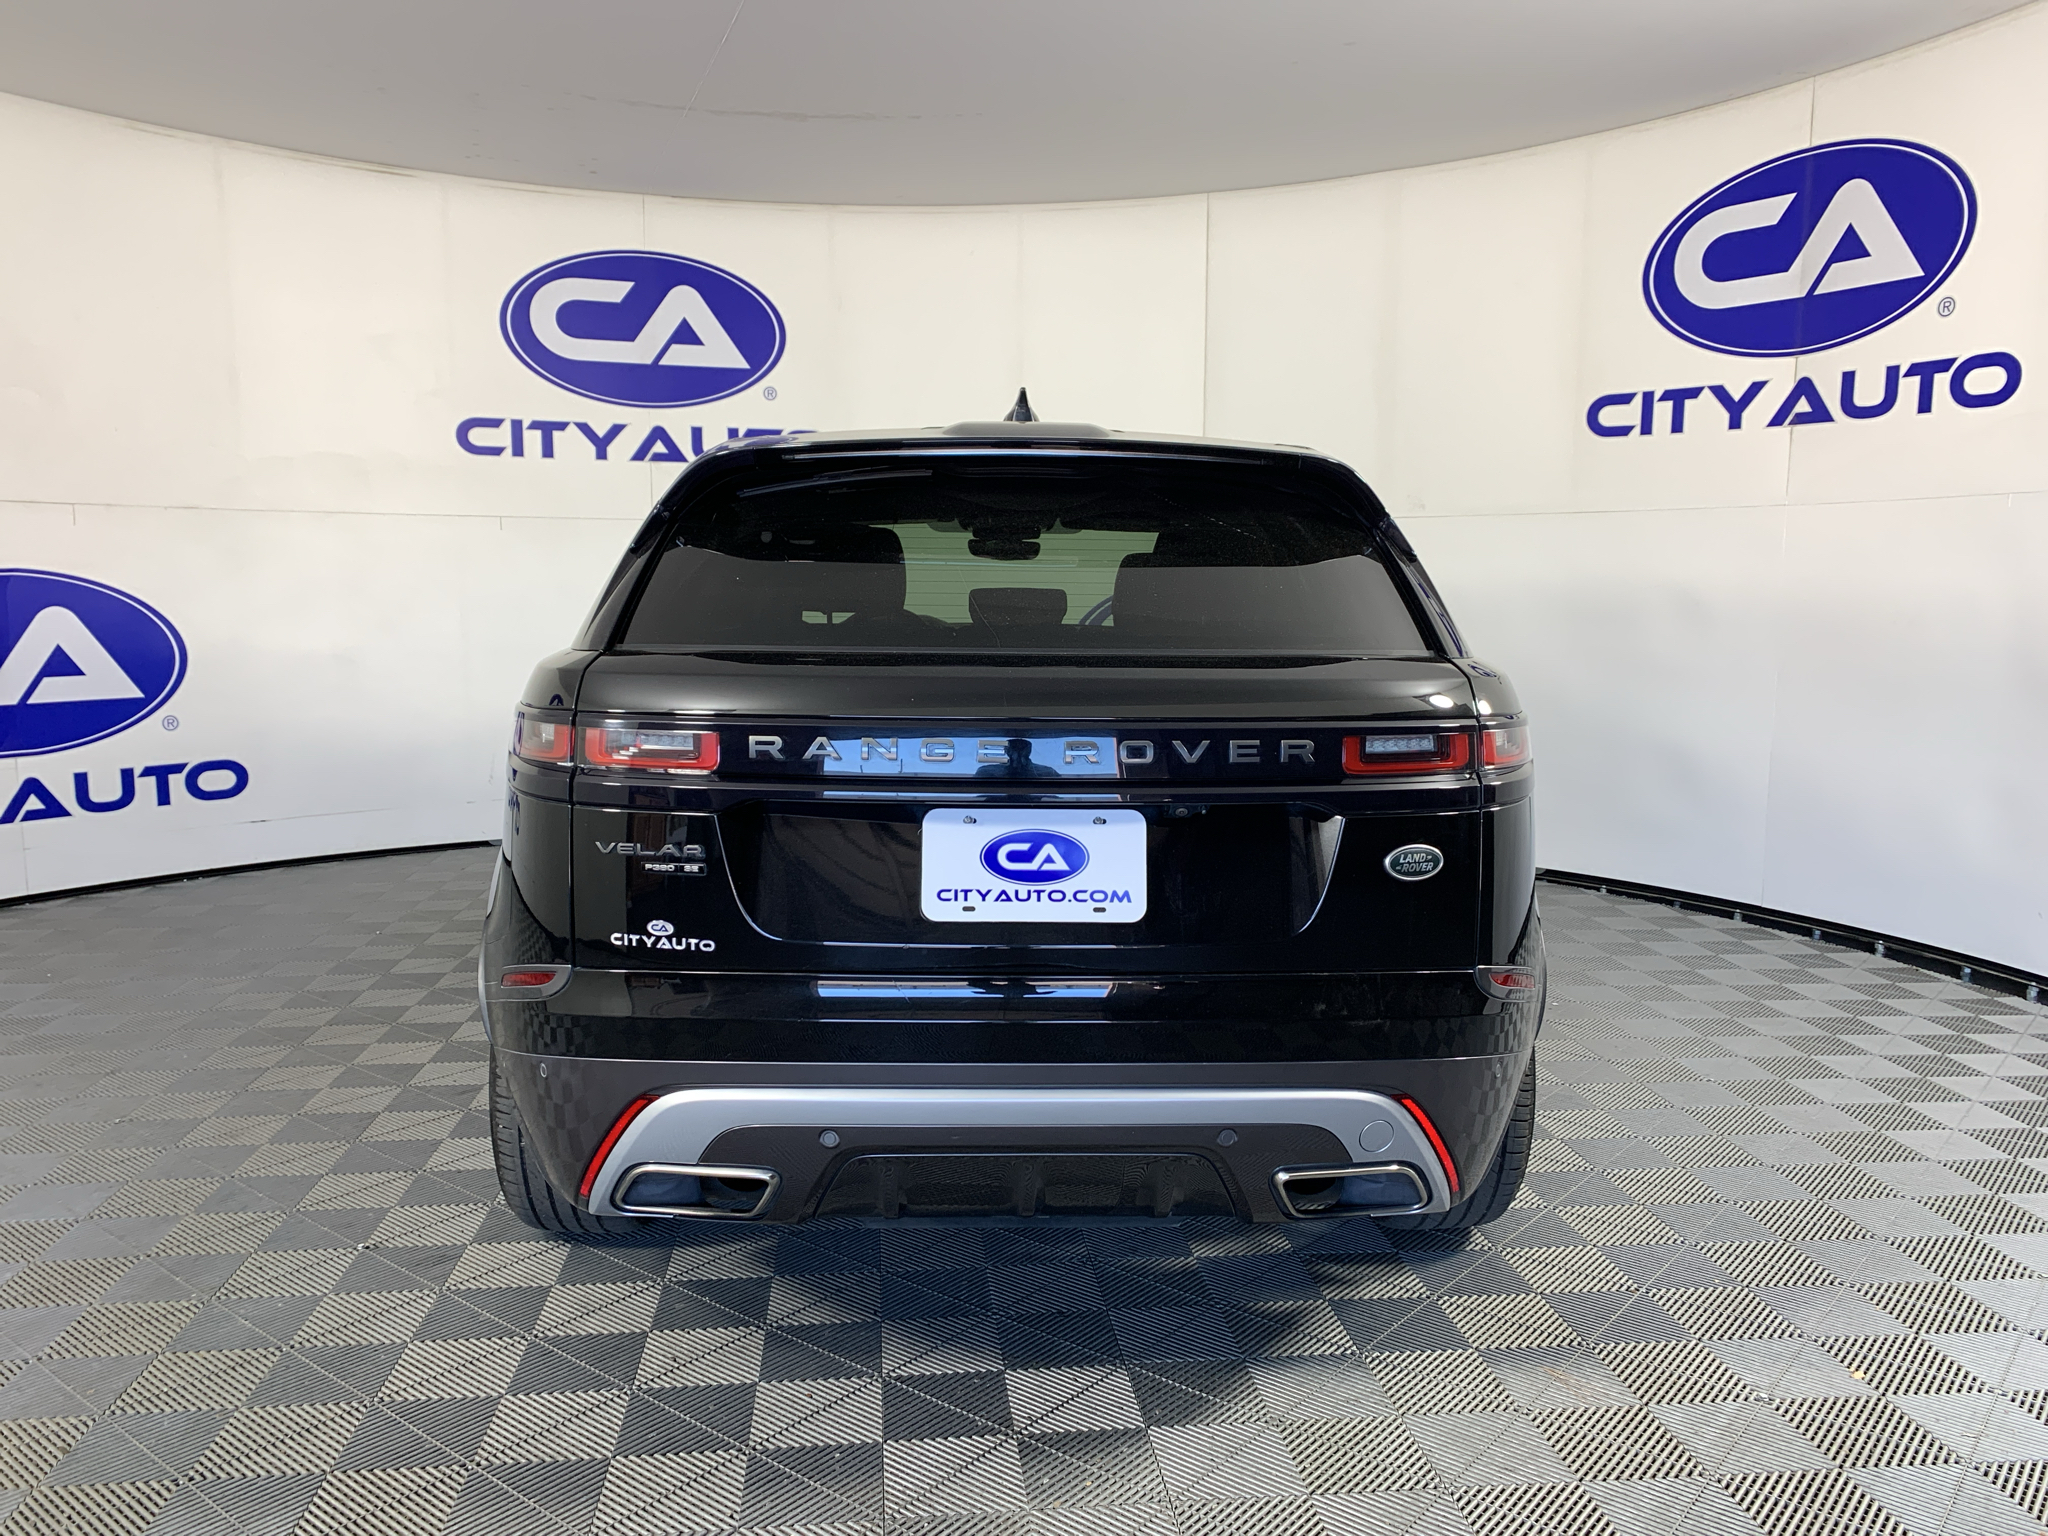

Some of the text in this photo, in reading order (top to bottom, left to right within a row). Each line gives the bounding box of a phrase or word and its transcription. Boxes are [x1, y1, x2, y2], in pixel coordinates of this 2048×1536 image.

[748, 735, 1315, 765] RANGE ROVER
[595, 841, 706, 858] VELAR
[997, 842, 1072, 872] CA
[1399, 852, 1426, 864] LAND
[1401, 862, 1434, 873] ROVER
[936, 888, 1133, 904] CITYAUTO.COM
